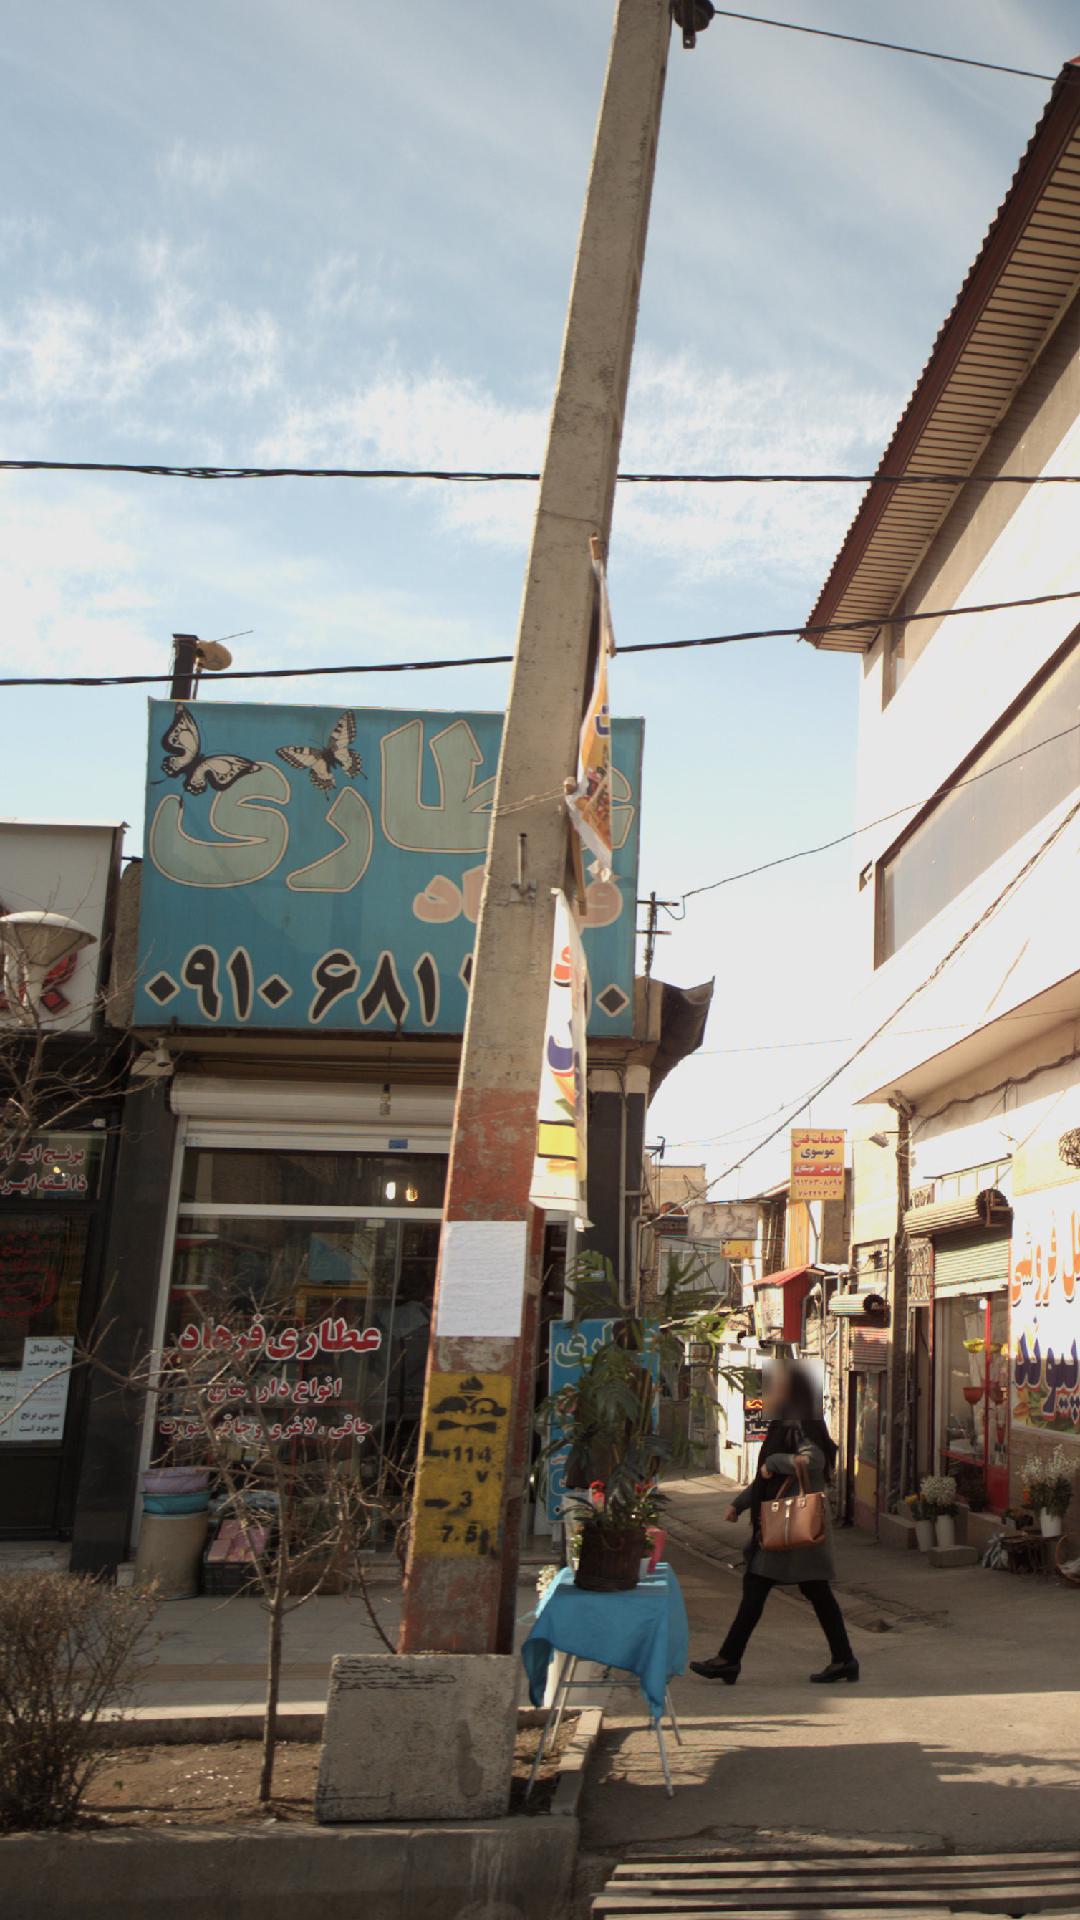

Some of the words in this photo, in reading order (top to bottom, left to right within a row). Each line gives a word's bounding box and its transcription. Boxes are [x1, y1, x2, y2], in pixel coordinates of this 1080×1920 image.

[149, 718, 634, 893] طاری
[42, 1144, 85, 1166] برنج
[800, 1148, 835, 1159] موسوی
[179, 1313, 266, 1361] فرهاد
[266, 1317, 382, 1360] عطاری
[1014, 1315, 1080, 1426] پیوند
[291, 1376, 343, 1403] انواع
[269, 1415, 318, 1441] لاغری
[328, 1415, 373, 1444] چاقی
